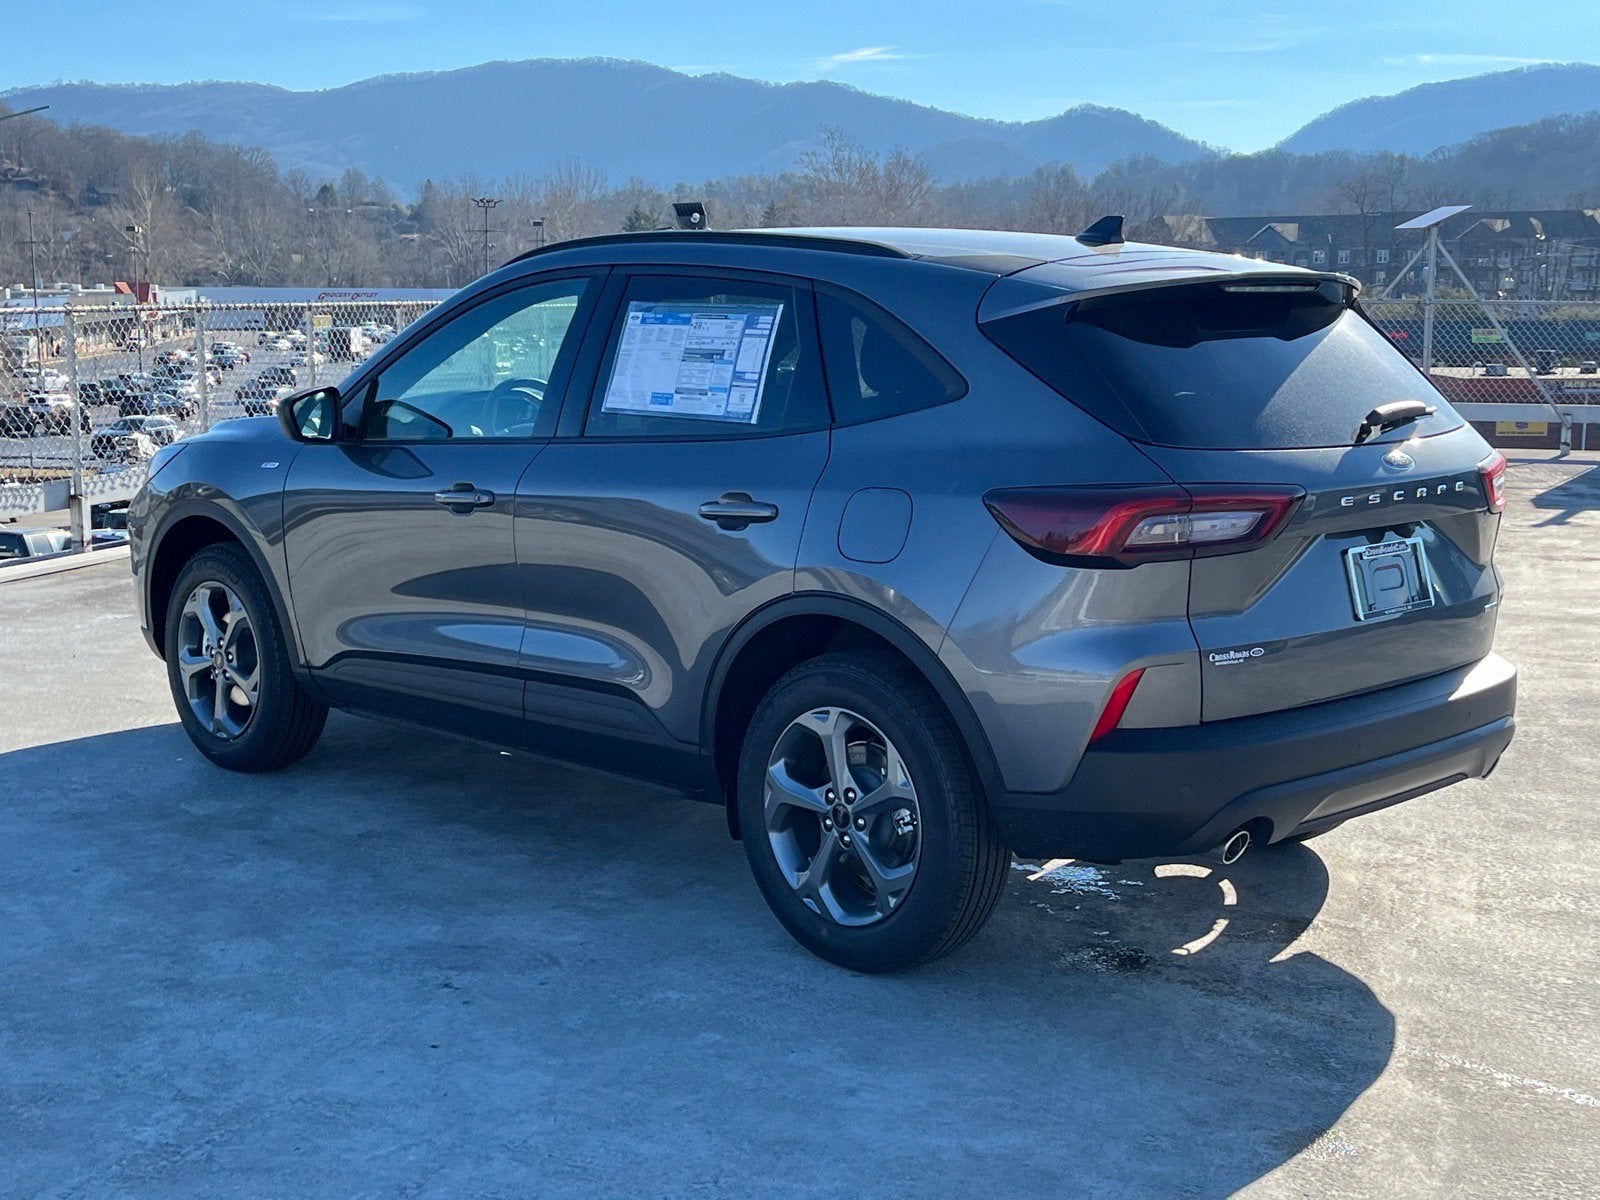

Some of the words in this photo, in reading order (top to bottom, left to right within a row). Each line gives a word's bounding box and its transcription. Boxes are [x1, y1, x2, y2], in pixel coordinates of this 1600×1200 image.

[318, 292, 350, 301] GROCERY
[351, 292, 378, 300] OUTLET
[1341, 481, 1464, 507] ESCAPE
